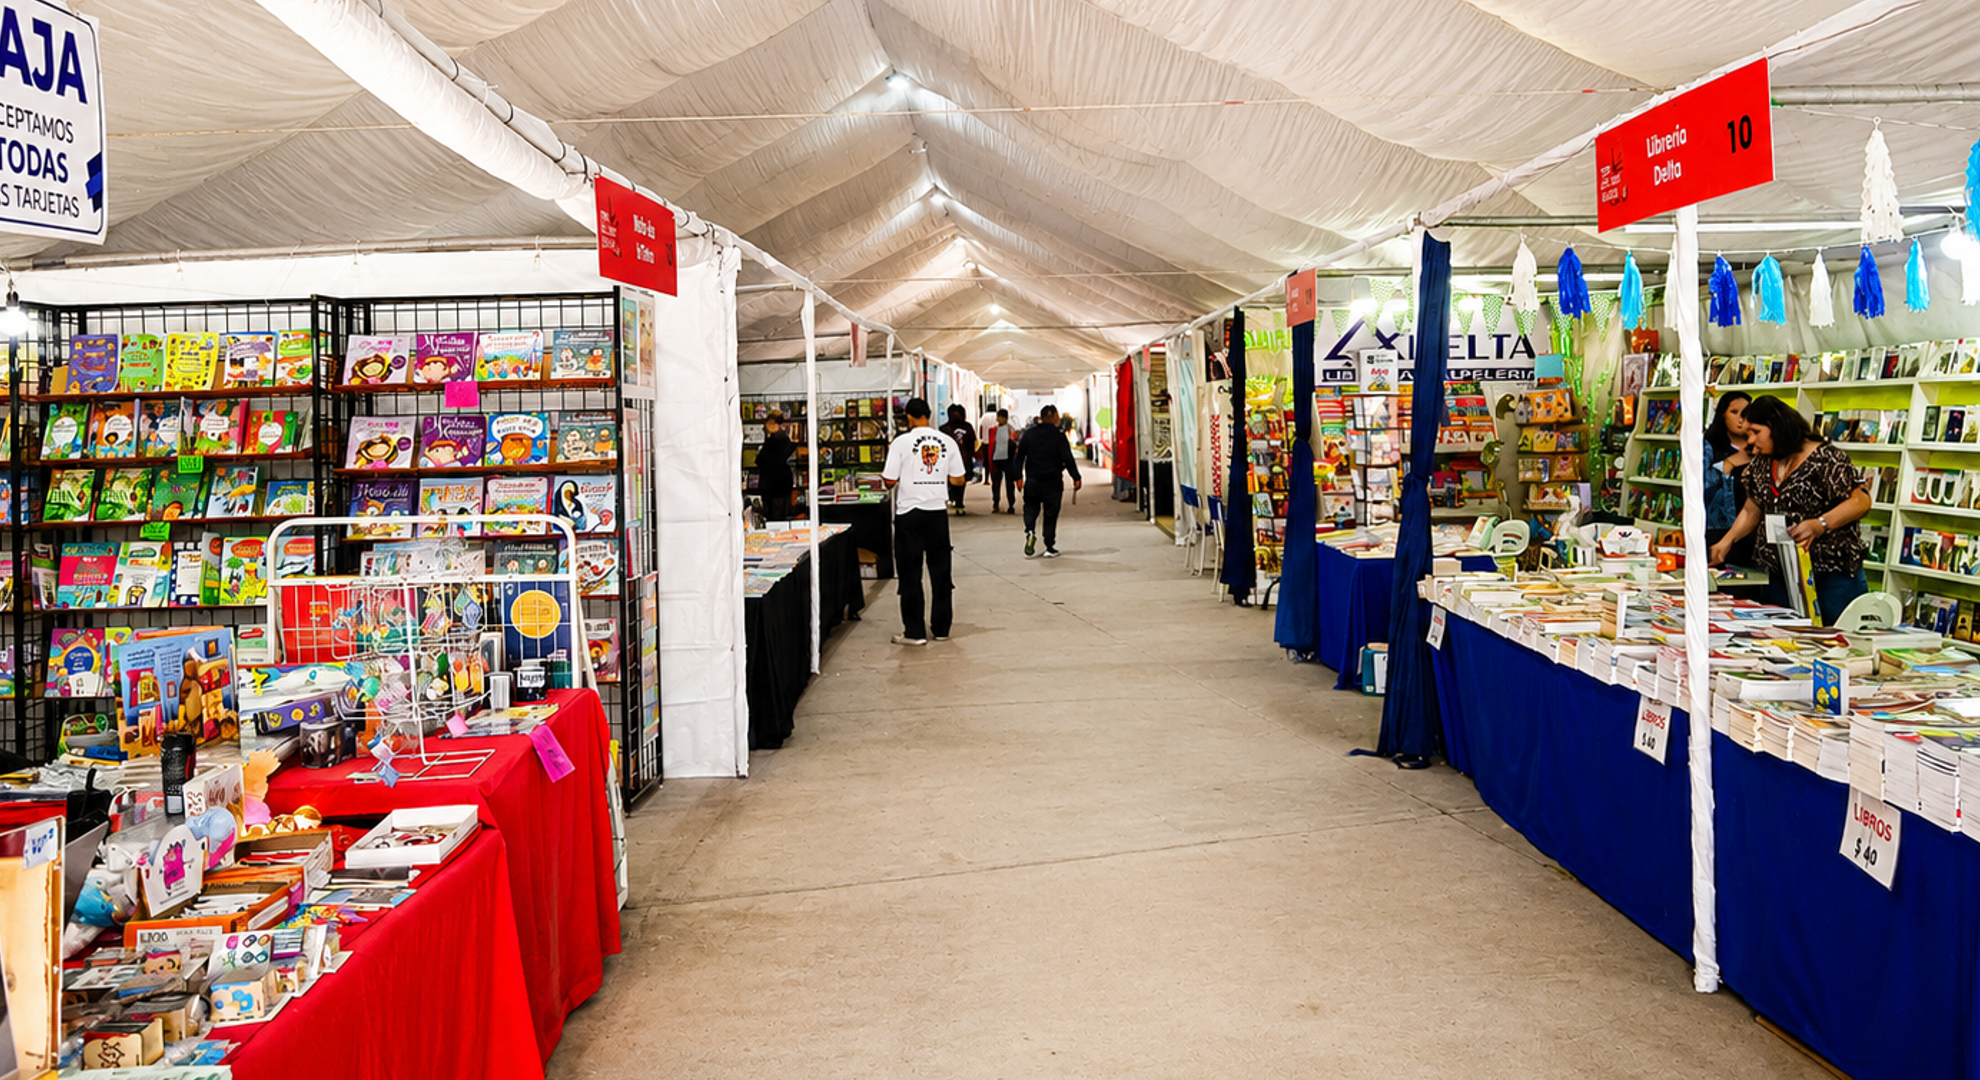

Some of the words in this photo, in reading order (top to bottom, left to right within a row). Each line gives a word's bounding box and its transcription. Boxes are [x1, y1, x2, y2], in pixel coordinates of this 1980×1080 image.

[1726, 114, 1753, 155] 10
[13, 184, 81, 219] TARJETAS
[1853, 802, 1893, 842] LIBROS
[1863, 845, 1878, 868] 40
